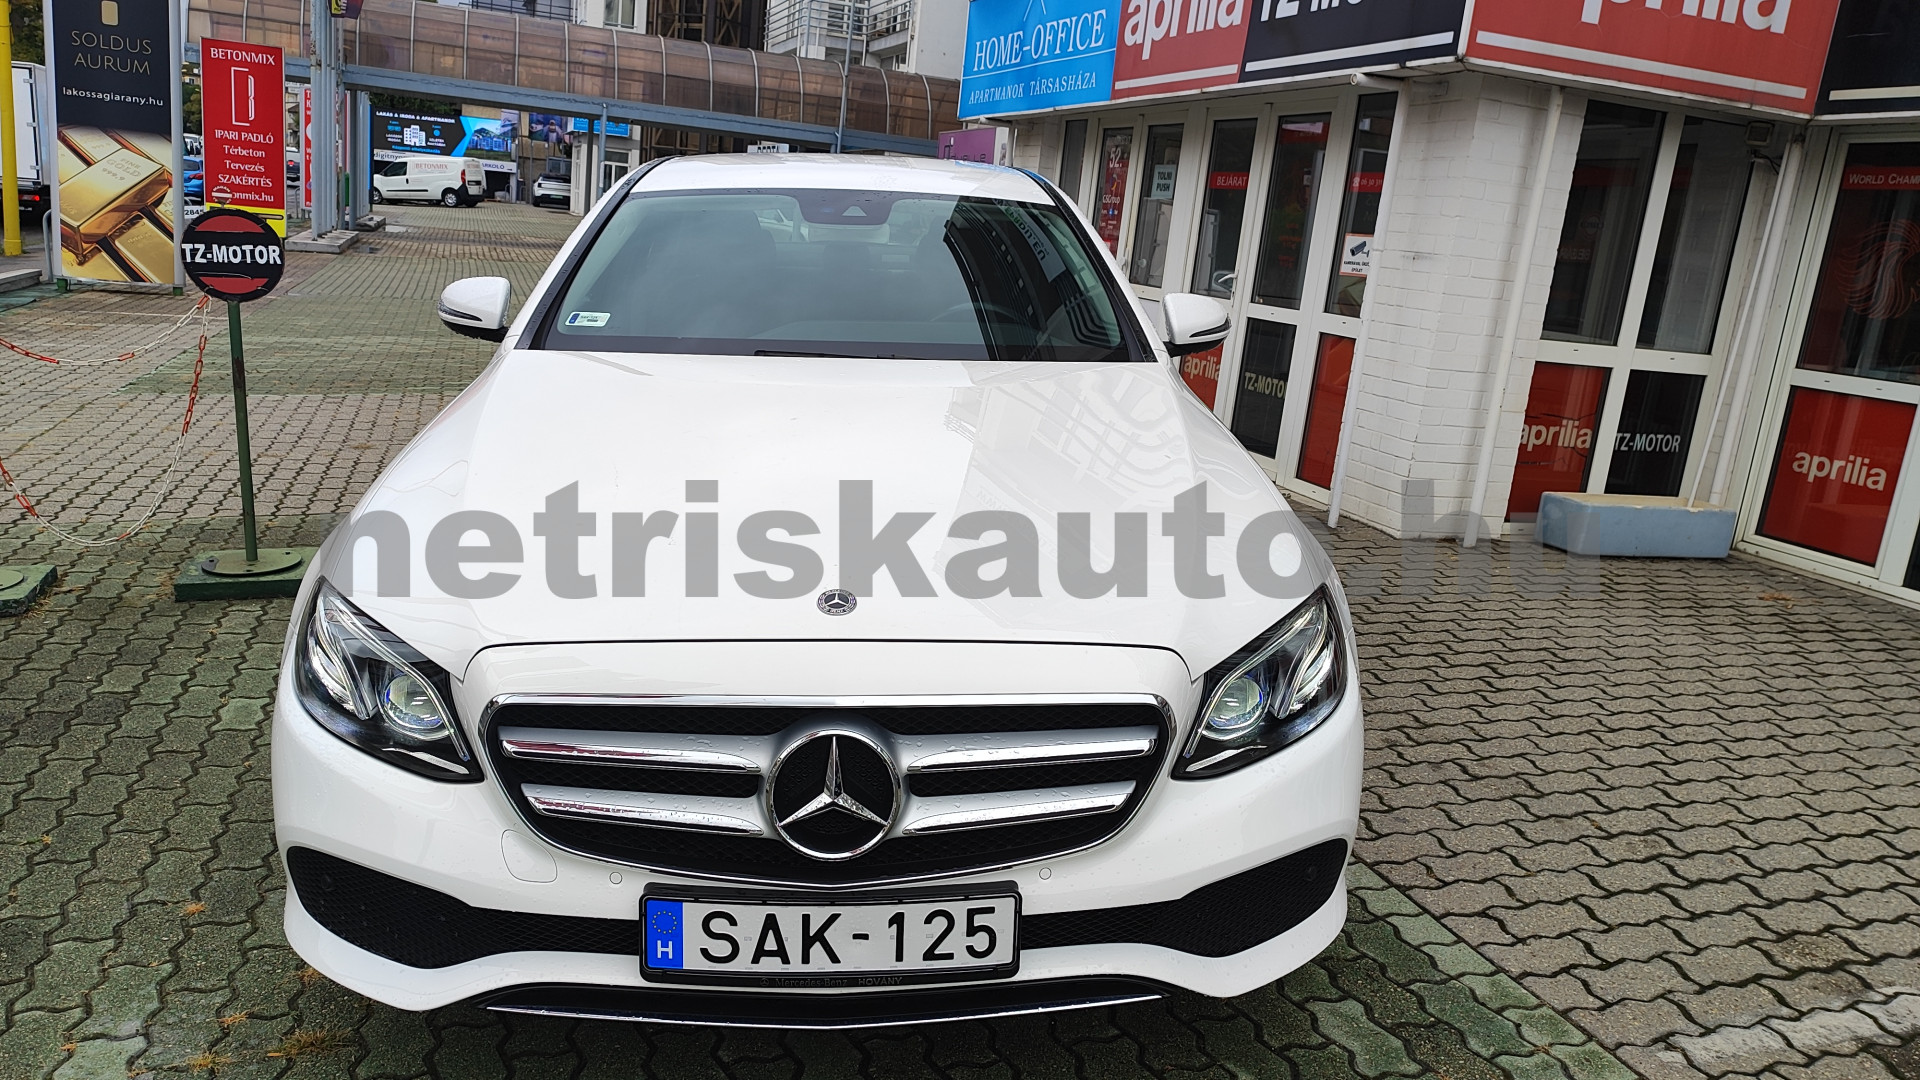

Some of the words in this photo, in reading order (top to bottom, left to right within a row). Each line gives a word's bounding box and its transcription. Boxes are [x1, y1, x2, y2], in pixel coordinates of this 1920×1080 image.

[71, 30, 152, 55] SOLDUS
[973, 9, 1107, 71] HOME-OFFICE
[74, 52, 151, 76] AURUM
[210, 47, 275, 66] BETONMIX
[62, 86, 164, 107] lakossagiarany.hu
[968, 83, 1025, 105] APARTMANOK
[1029, 70, 1096, 96] TÁRSASHÁZA
[214, 129, 239, 141] IPARI
[241, 131, 274, 144] PADLÓ
[222, 144, 266, 158] Térbeton
[224, 159, 265, 173] Tervezés
[218, 173, 273, 188] SZAKÉRTÉS
[1156, 183, 1171, 192] PUSH
[1216, 174, 1247, 187] BEJÁRAT
[182, 243, 282, 265] TZ-MOTOR
[1244, 371, 1288, 399] TZ-MOTO
[1519, 419, 1593, 451] aprilia
[1614, 432, 1682, 453] TZ-MOTOR
[1792, 451, 1887, 491] aprilia
[699, 906, 998, 966] SAK-125
[657, 940, 673, 960] H
[775, 977, 848, 987] Mercedes-Benz
[858, 976, 903, 987] HOVÁNY
